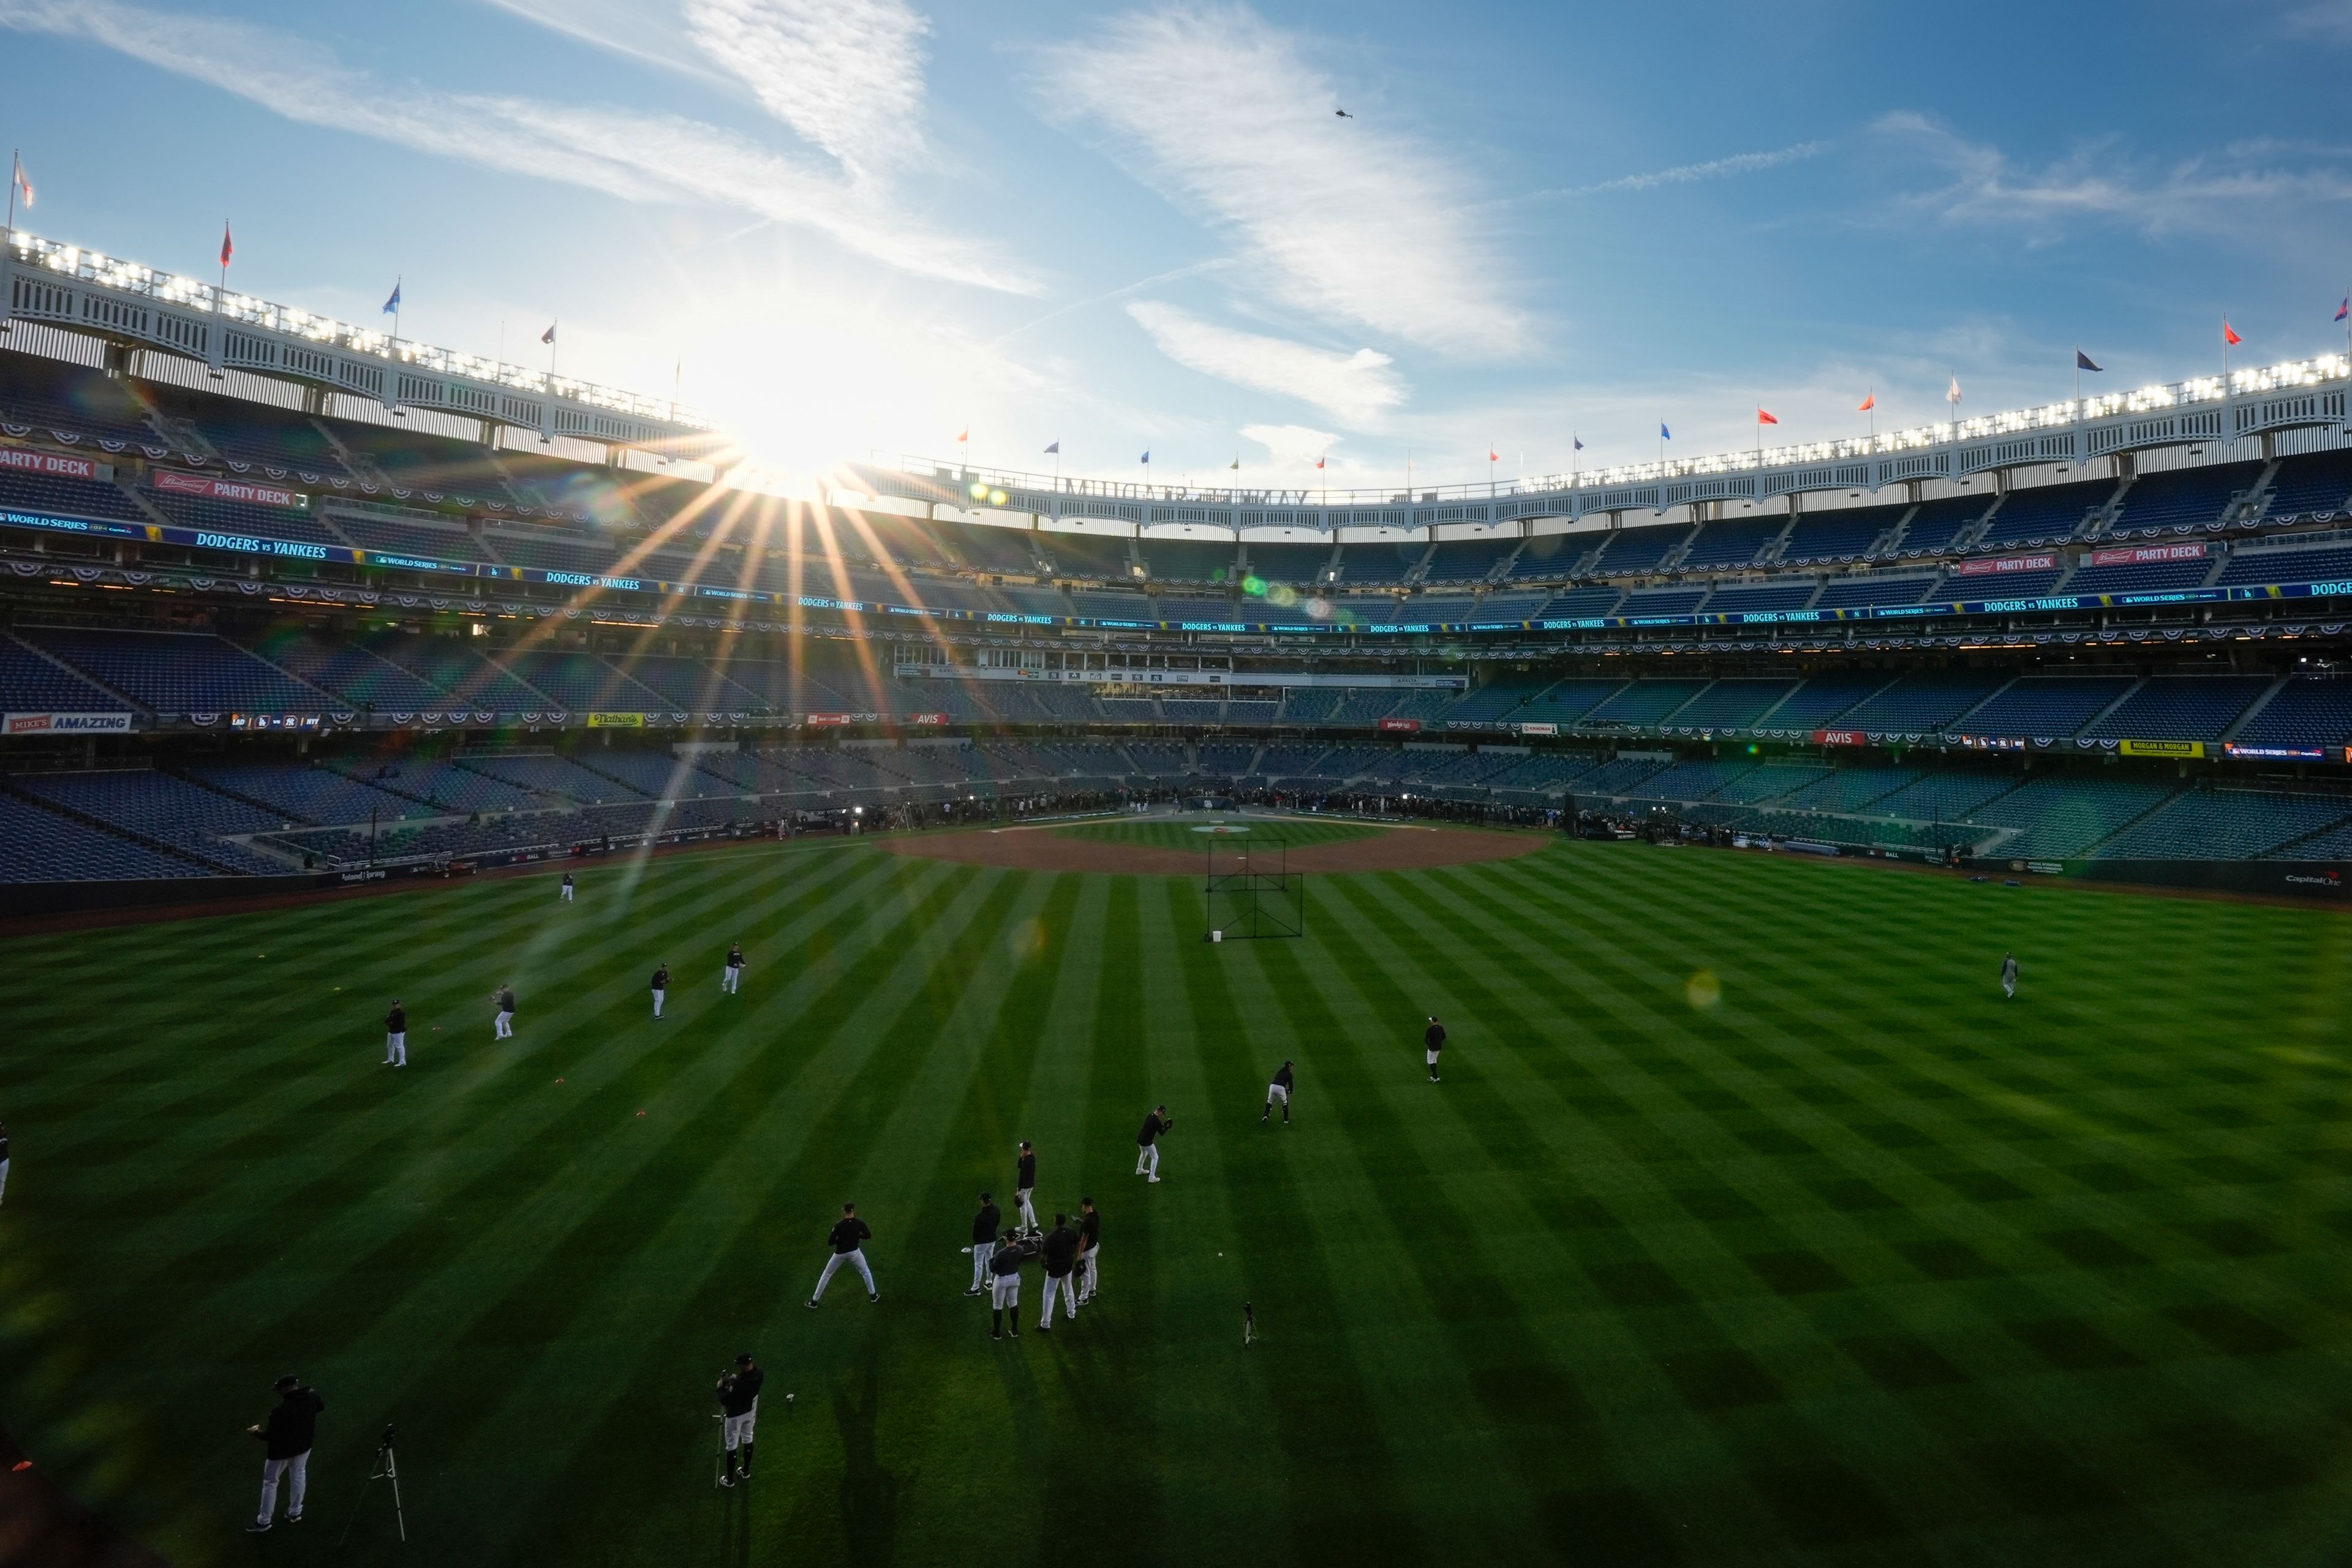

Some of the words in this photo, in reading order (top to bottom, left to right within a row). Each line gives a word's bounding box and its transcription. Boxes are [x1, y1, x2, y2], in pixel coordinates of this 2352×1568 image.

[47, 458, 89, 475] DECK
[165, 478, 204, 489] Budweiser
[214, 483, 254, 499] PARTY
[257, 489, 290, 505] DECK
[7, 513, 49, 526] WORLD
[50, 519, 88, 530] SERIES
[196, 533, 260, 552] DODGERS
[274, 541, 326, 559] YANKEES
[2136, 548, 2168, 560] PARTY
[2171, 545, 2199, 558] DECK
[388, 557, 413, 566] WORLD
[1997, 559, 2024, 570] PARTY
[2026, 557, 2051, 568] DECK
[546, 572, 591, 586] DODGERS
[601, 578, 639, 590] YANKEES
[2311, 581, 2352, 595] DODGE
[798, 597, 829, 608] DODGERS
[836, 600, 863, 611] YANKEES
[1985, 600, 2026, 612] DODGERS
[2036, 598, 2078, 609] YANKEES
[987, 613, 1017, 622] DODGERS
[1024, 615, 1052, 624] YANKEES
[1743, 613, 1777, 622] DODGERS
[1785, 612, 1819, 621] YANKEES
[1182, 622, 1212, 631] DODGERS
[1544, 620, 1571, 629] DODGERS
[1577, 619, 1604, 628] YANKEES
[15, 719, 47, 729] MIKE'S
[54, 717, 126, 729] AMAZING
[594, 714, 638, 724] Nathan's
[918, 714, 938, 723] AVIS
[1825, 732, 1852, 744] AVIS
